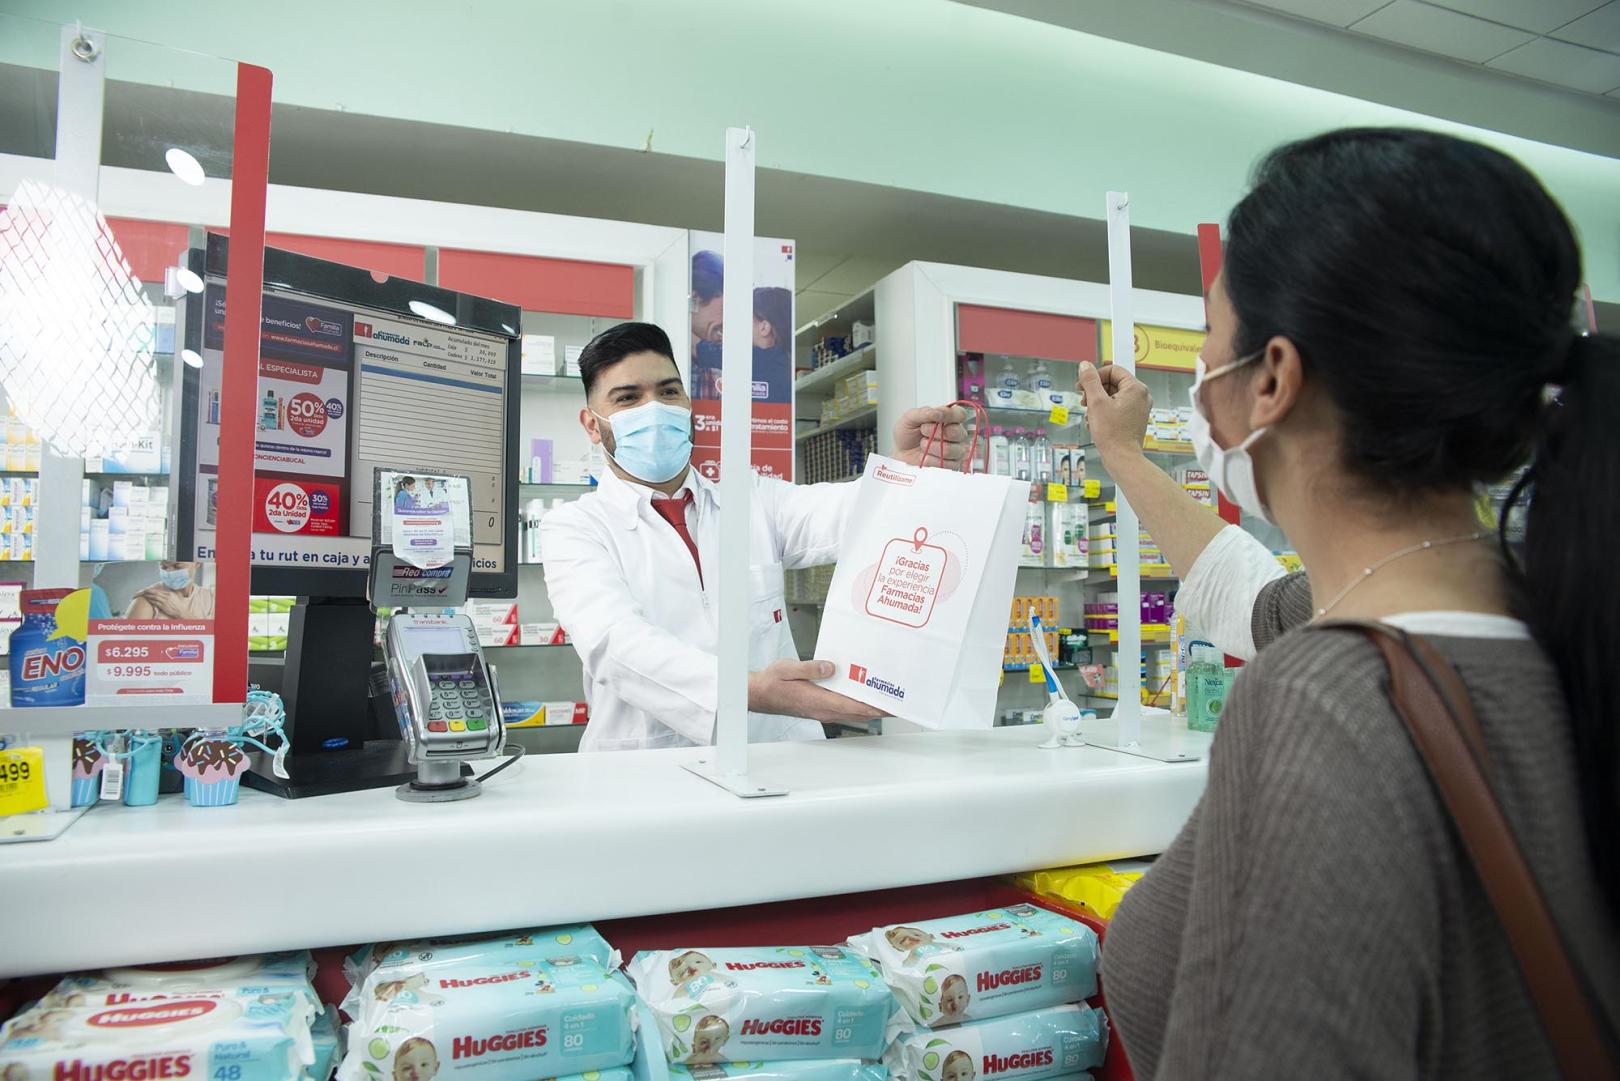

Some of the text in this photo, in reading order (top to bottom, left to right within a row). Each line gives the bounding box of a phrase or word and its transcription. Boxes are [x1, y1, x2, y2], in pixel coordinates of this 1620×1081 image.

[365, 350, 399, 362] Descripción
[266, 363, 318, 378] ESPECIALISTA
[423, 361, 447, 371] Cantidad
[470, 369, 484, 377] Valor
[290, 399, 325, 417] 50%
[326, 402, 342, 411] 40%
[303, 417, 324, 425] unidad
[694, 415, 705, 431] 3
[268, 491, 308, 510] 40%
[312, 494, 328, 503] 30%
[283, 510, 307, 518] Unidad
[260, 550, 274, 561] tu
[278, 550, 298, 562] rut
[302, 553, 319, 562] en
[322, 552, 349, 566] caja
[352, 555, 360, 566] y
[895, 556, 930, 572] ¡Gracias
[889, 567, 930, 583] por elegir
[391, 583, 436, 594] PinPass
[878, 573, 935, 595] la experiencia
[881, 585, 925, 603] Farmacias
[877, 595, 923, 614] Ahumada!
[97, 623, 136, 632] Protégete
[162, 623, 170, 631] la
[22, 646, 85, 681] ENO
[866, 677, 905, 699] ahumada
[976, 965, 1042, 992] HUGGIES
[741, 1018, 822, 1036] HUGGIES
[835, 1028, 852, 1040] 80
[452, 1028, 548, 1060] HUGGIES
[564, 1033, 583, 1048] 80
[53, 1055, 192, 1081] HUGGIES
[983, 1050, 1053, 1075] HUGGIES
[213, 1064, 242, 1081] 48
